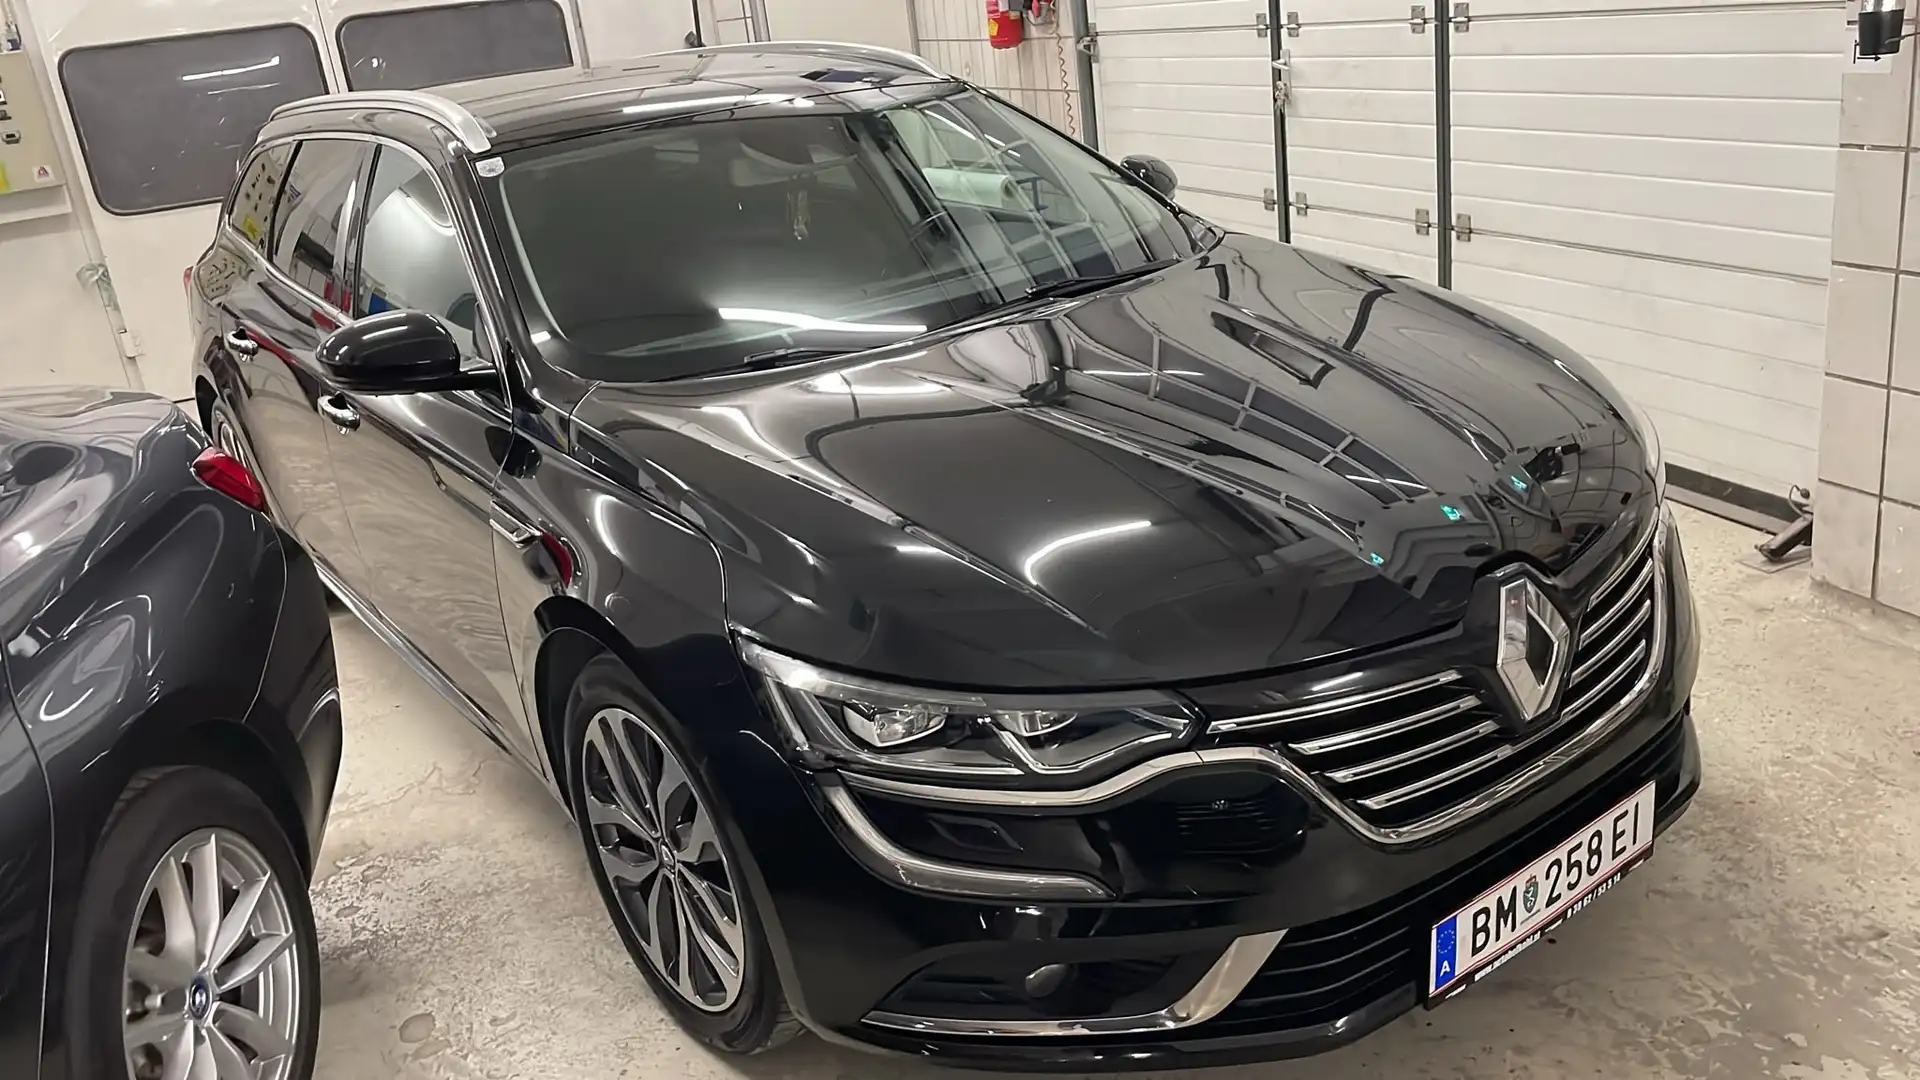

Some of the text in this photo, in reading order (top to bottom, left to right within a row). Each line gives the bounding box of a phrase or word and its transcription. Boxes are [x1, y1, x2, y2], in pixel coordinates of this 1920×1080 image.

[1471, 885, 1517, 958] BM
[1545, 829, 1603, 909] 258
[1612, 801, 1639, 861] EI
[1440, 960, 1451, 977] A
